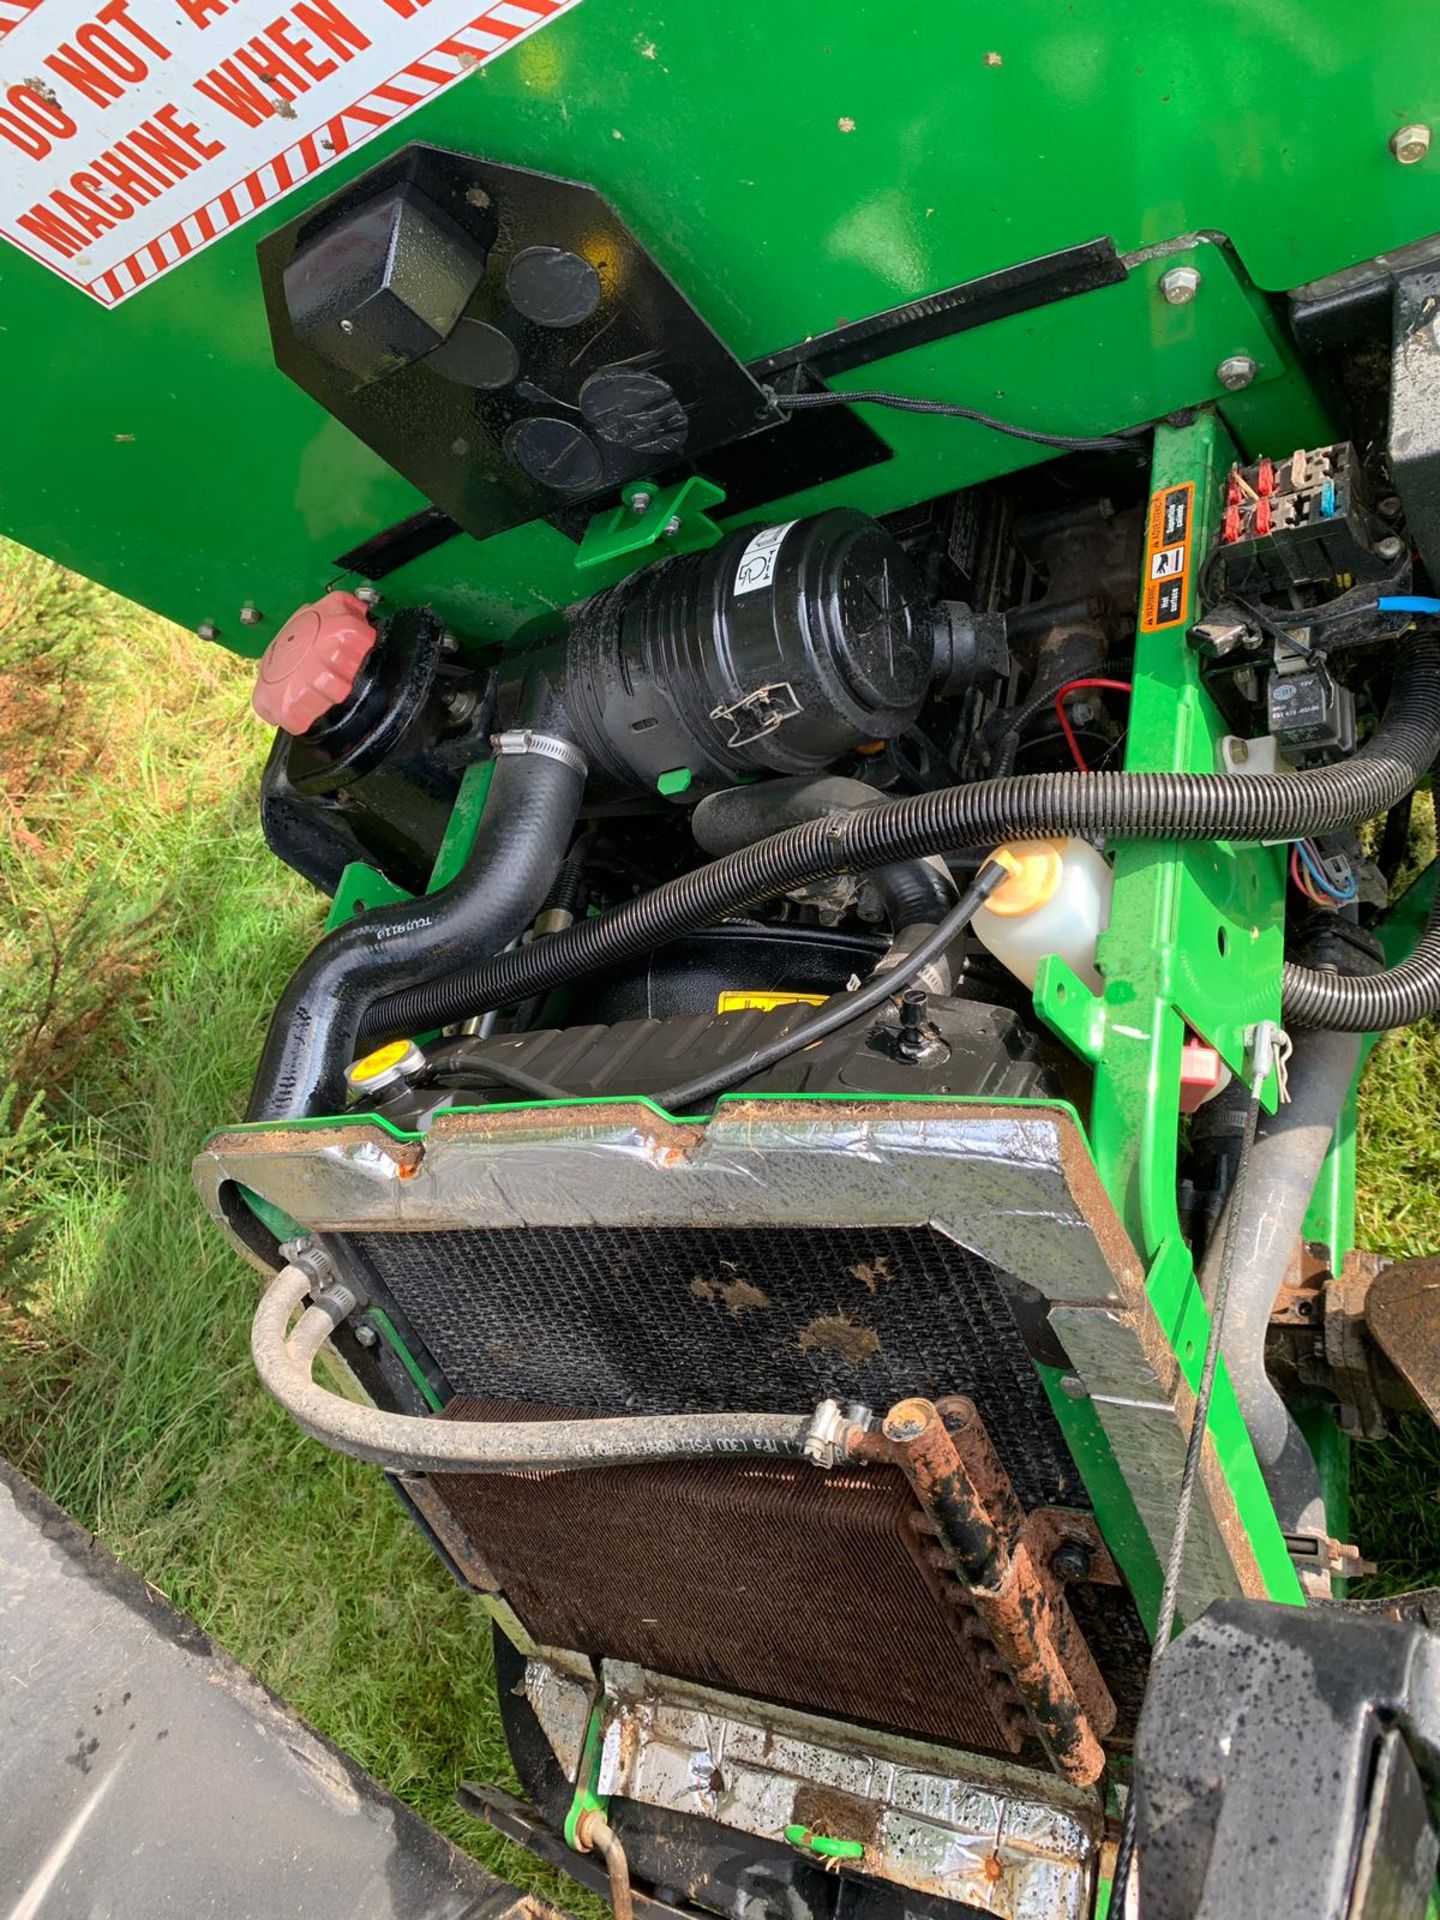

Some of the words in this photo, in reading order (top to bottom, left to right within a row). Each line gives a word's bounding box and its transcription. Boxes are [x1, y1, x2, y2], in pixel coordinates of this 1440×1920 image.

[0, 84, 77, 161] DO
[43, 0, 172, 109] NOT
[16, 103, 226, 259] MACHINE
[193, 0, 372, 128] WHEN
[752, 1439, 780, 1454] MPa
